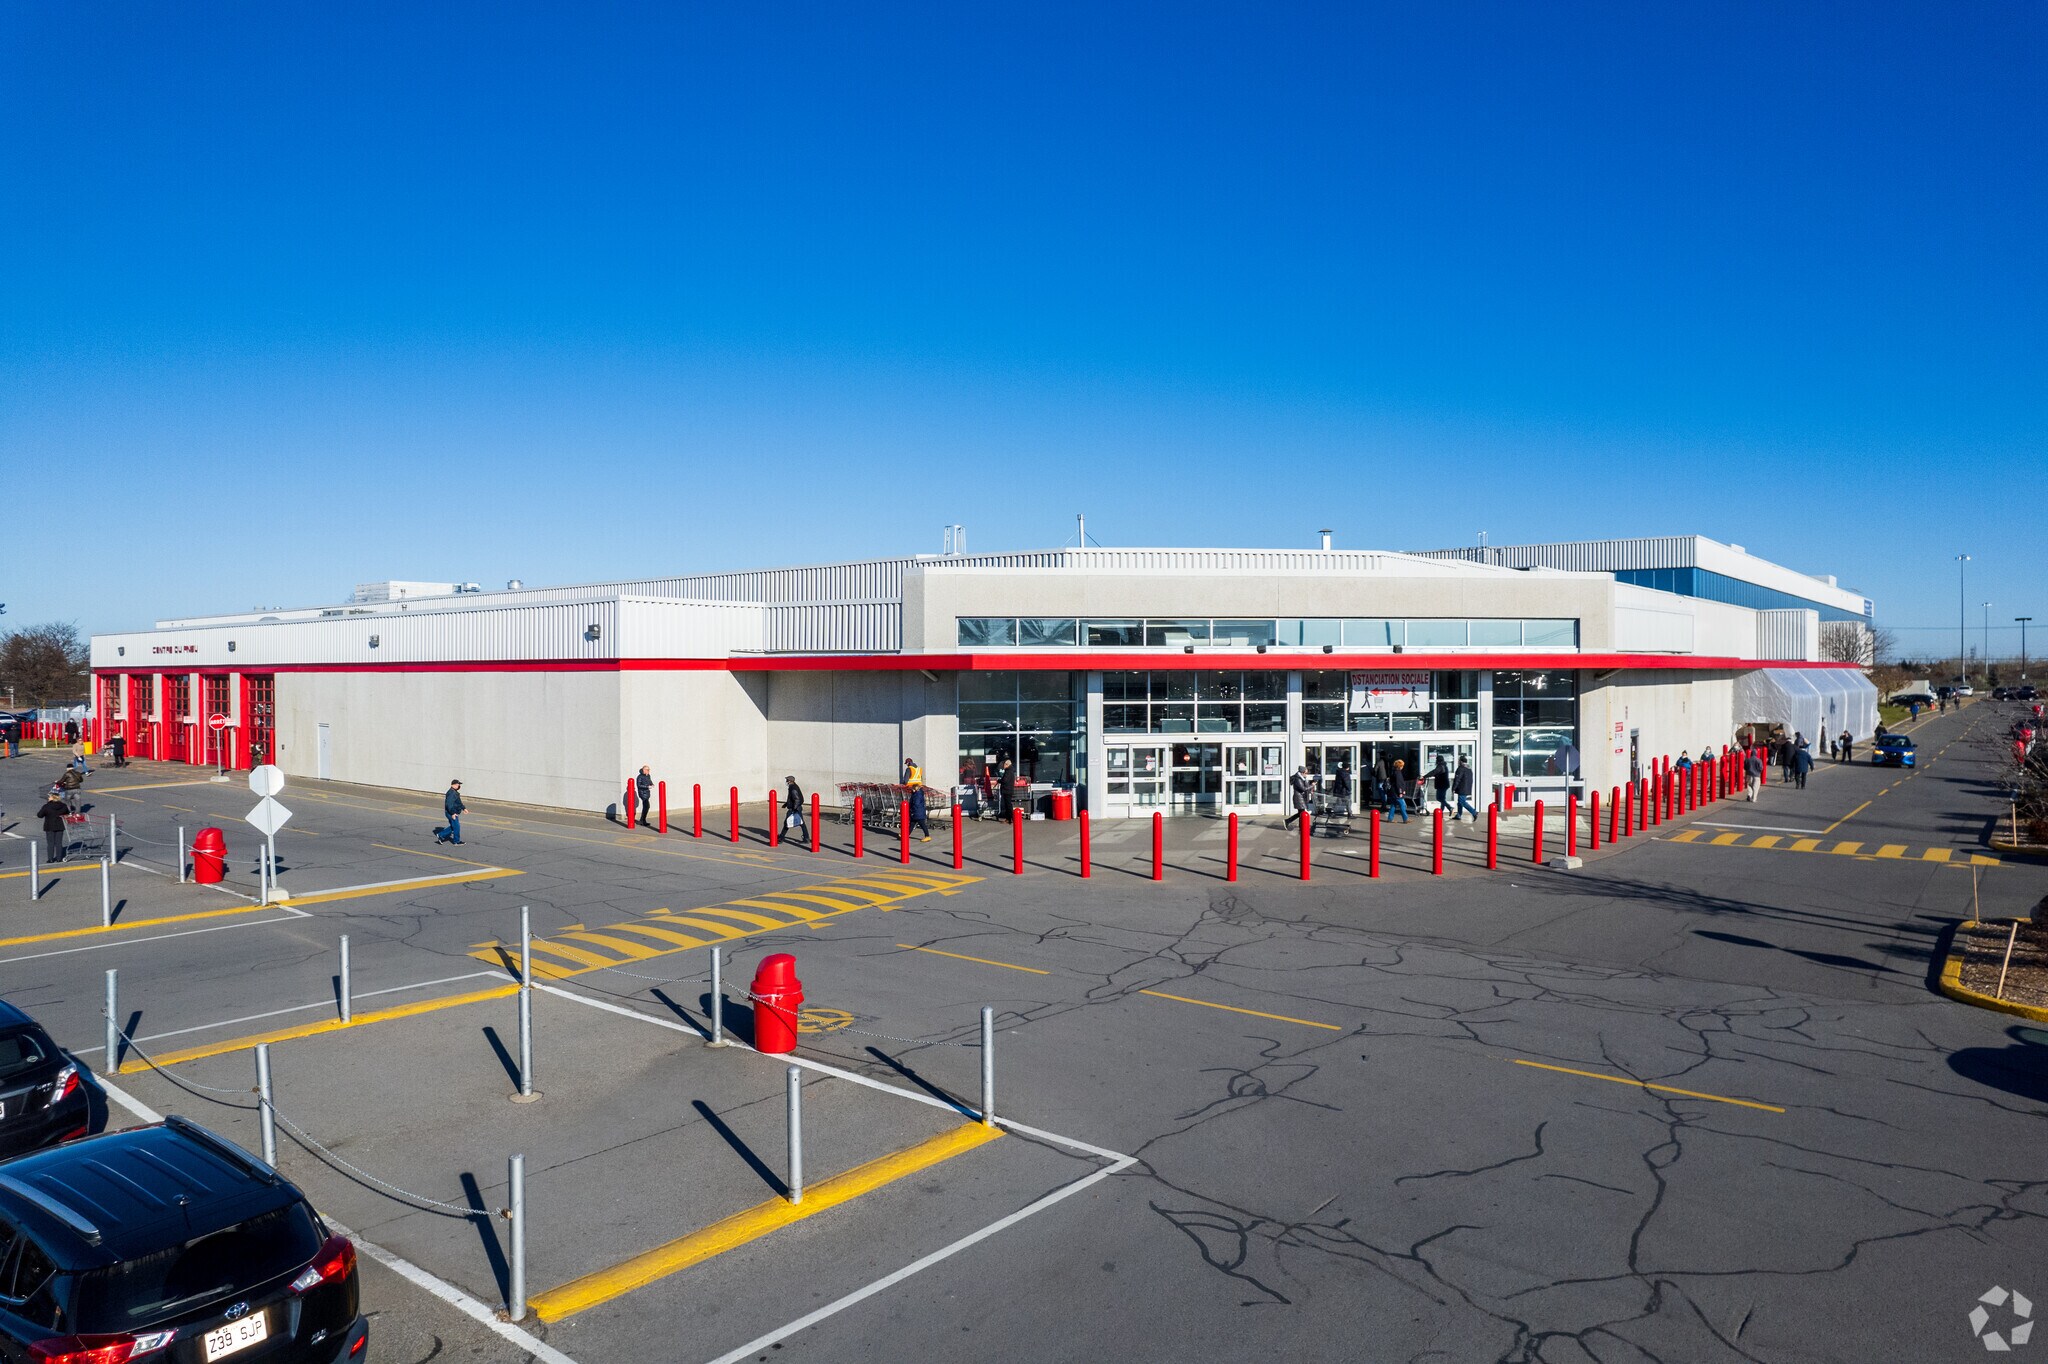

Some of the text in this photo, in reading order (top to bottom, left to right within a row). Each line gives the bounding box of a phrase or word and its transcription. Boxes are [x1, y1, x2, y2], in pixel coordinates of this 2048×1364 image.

[1401, 673, 1429, 684] SOCIALE
[209, 1320, 262, 1354] Z39 SJP
